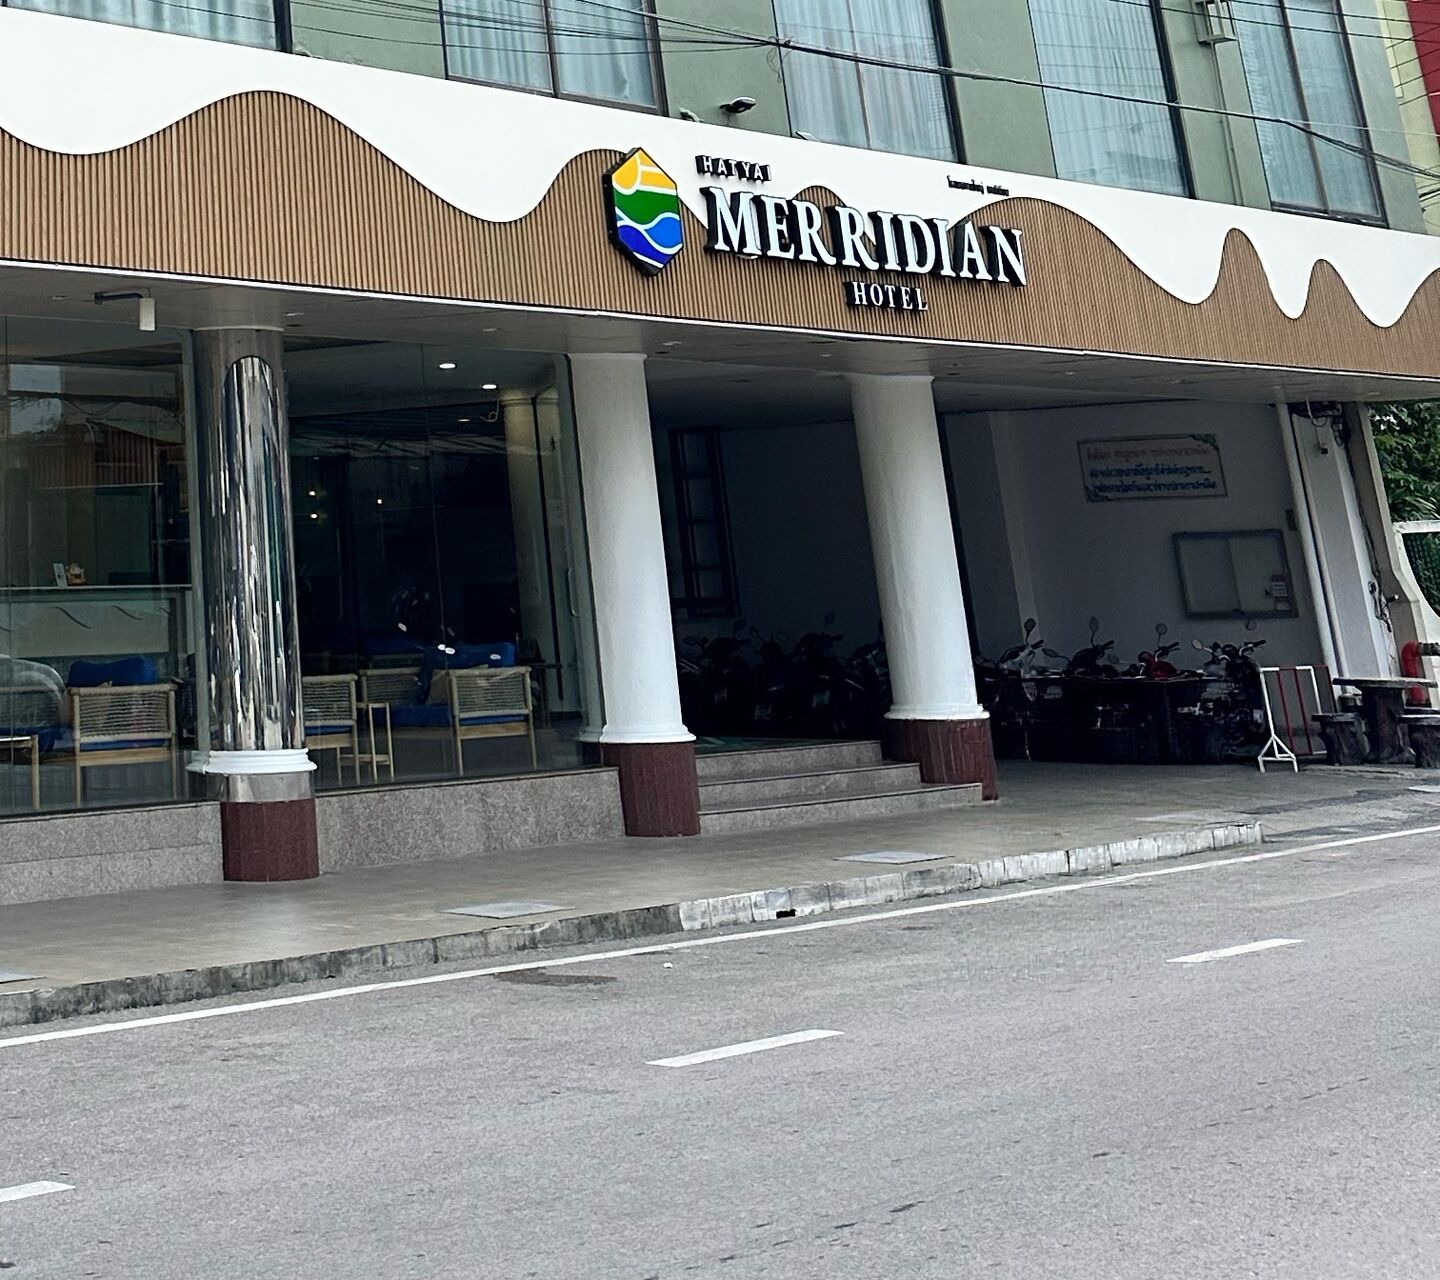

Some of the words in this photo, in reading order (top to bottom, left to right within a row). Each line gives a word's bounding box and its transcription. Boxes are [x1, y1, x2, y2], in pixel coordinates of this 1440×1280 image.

[698, 155, 771, 182] HATYAI
[702, 185, 1027, 287] MERRIDIAN
[849, 281, 928, 311] HOTEL
